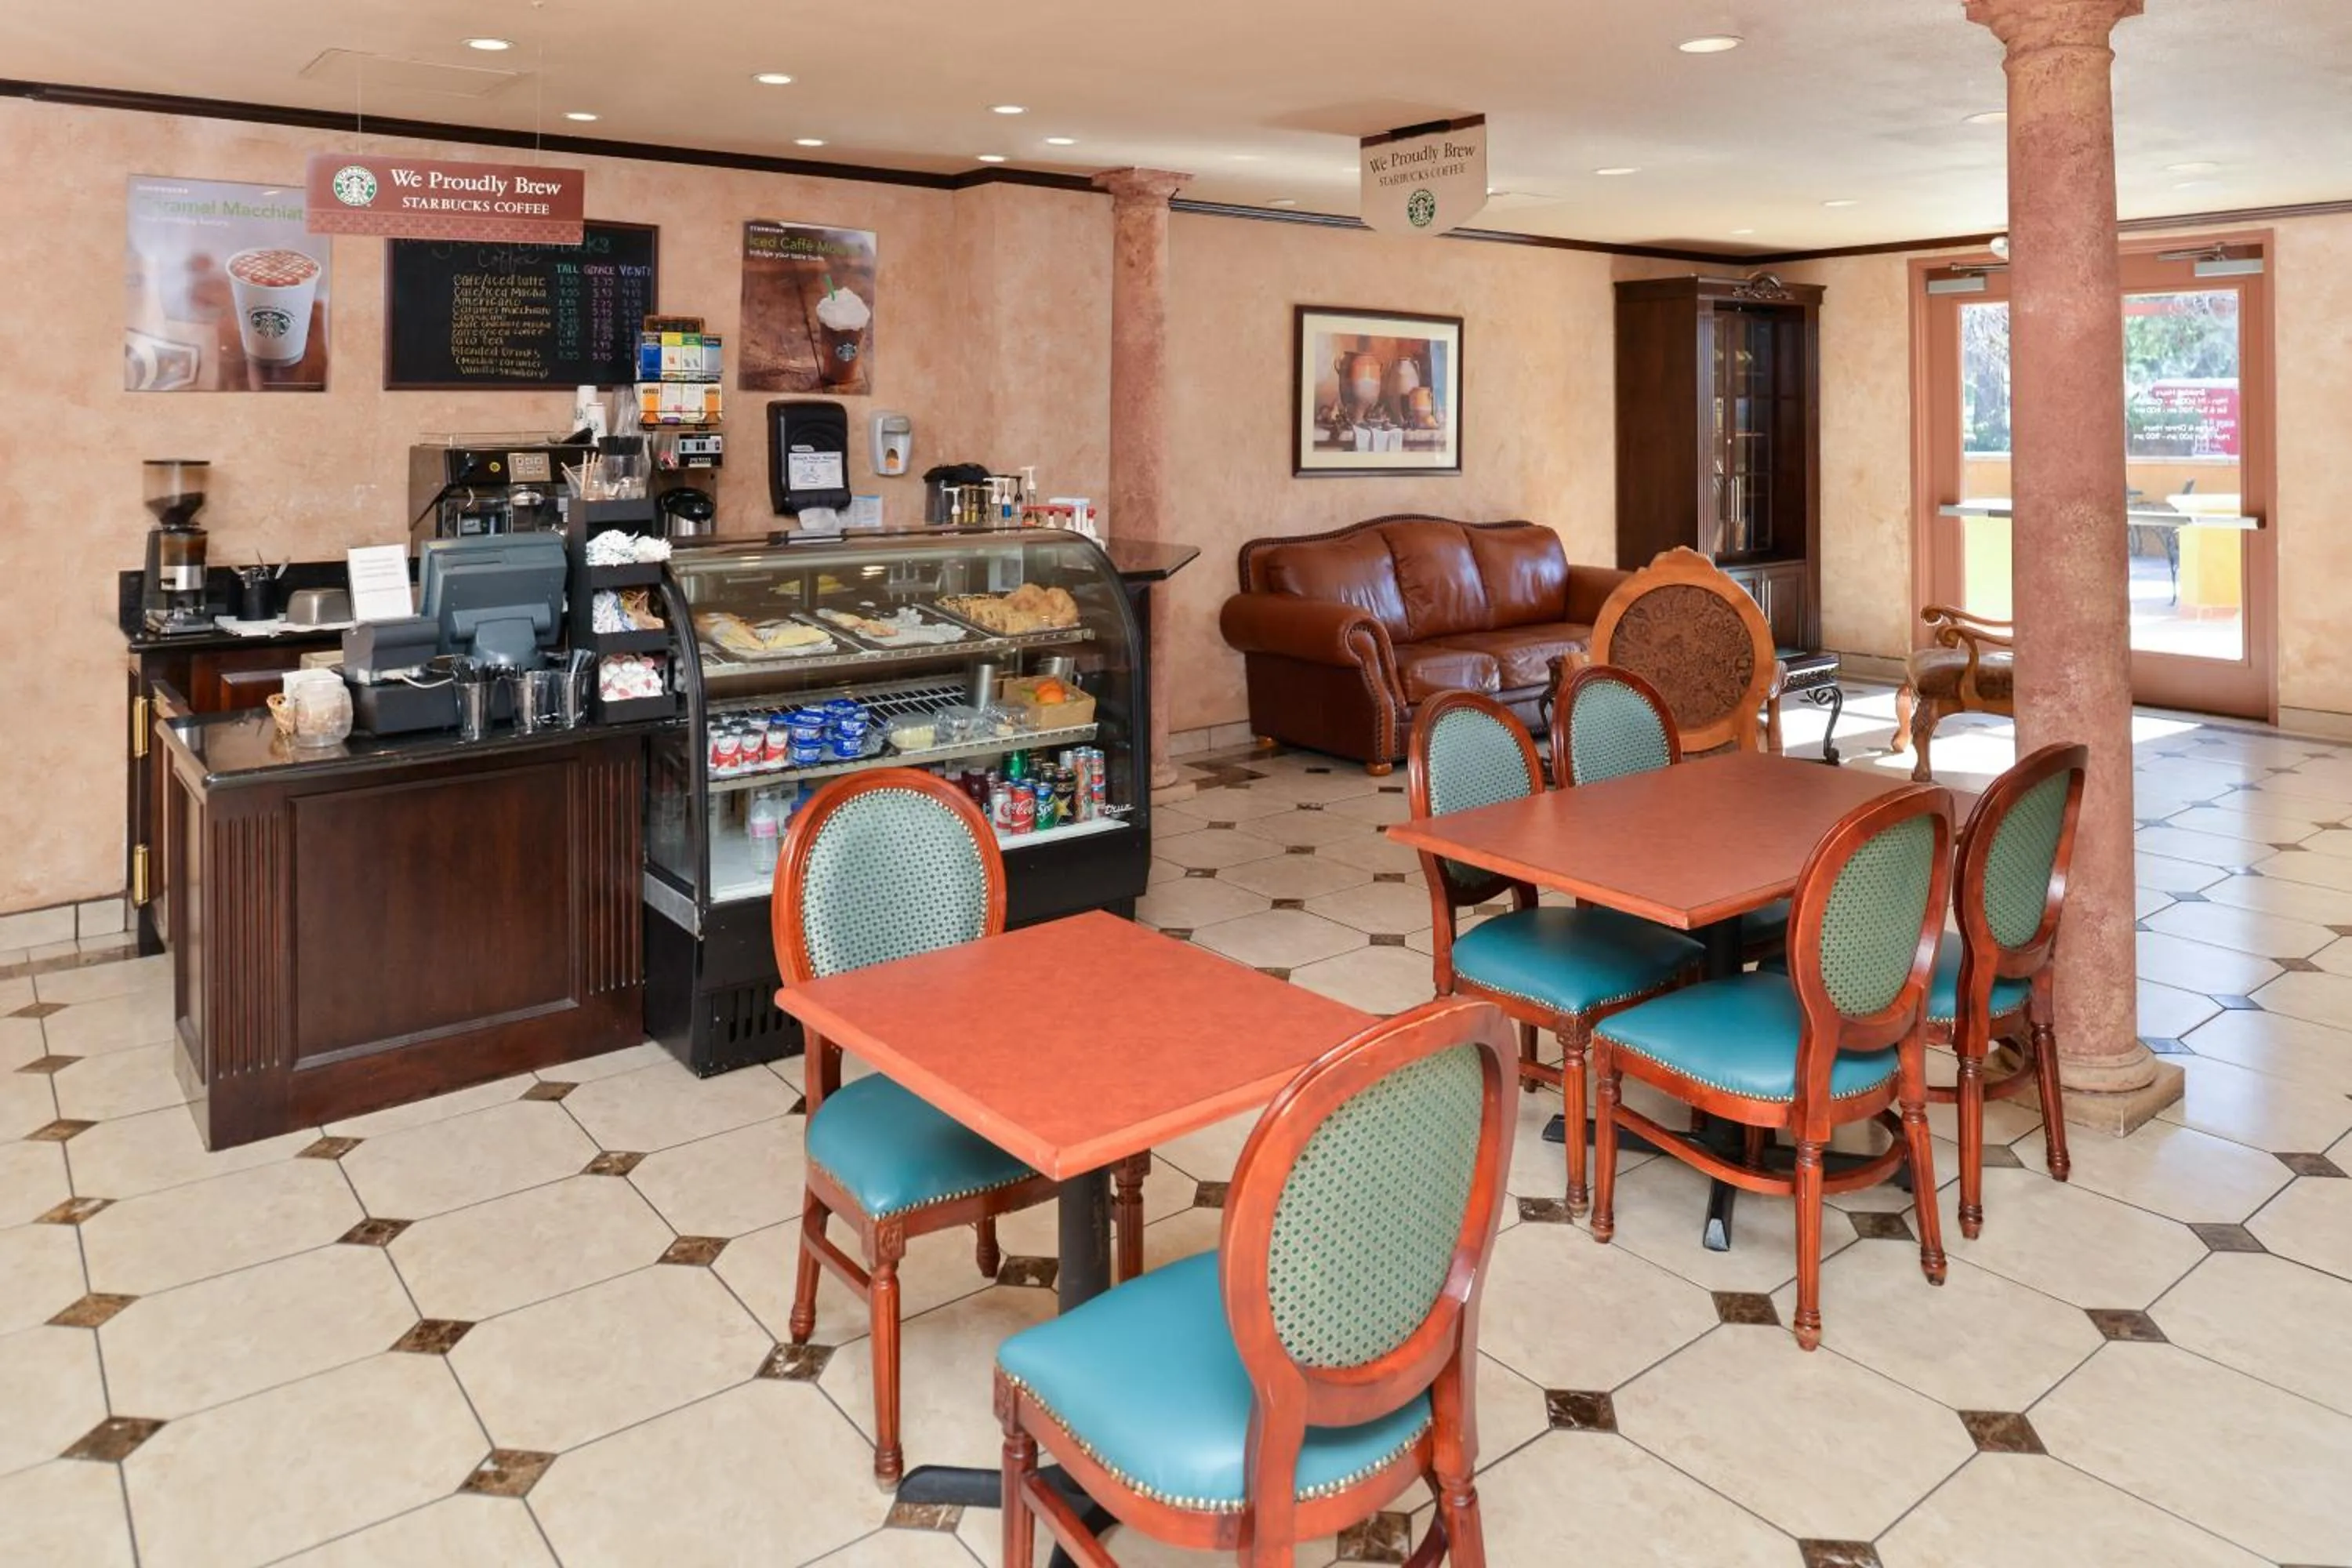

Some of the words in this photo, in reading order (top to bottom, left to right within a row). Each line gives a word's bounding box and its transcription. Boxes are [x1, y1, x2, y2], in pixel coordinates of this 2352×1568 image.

[1370, 157, 1388, 174] We
[1392, 144, 1439, 167] Proudly
[1445, 142, 1476, 158] Brew
[390, 168, 423, 188] We
[429, 171, 508, 197] Proudly
[515, 176, 562, 195] Brew
[1379, 170, 1429, 187] STARBUCKS
[1430, 162, 1467, 179] COFFEE
[222, 199, 304, 222] Macchiat
[402, 196, 491, 212] STARBUCKS
[494, 201, 550, 215] COFFEE
[750, 235, 777, 249] Iced
[556, 263, 579, 274] TALL
